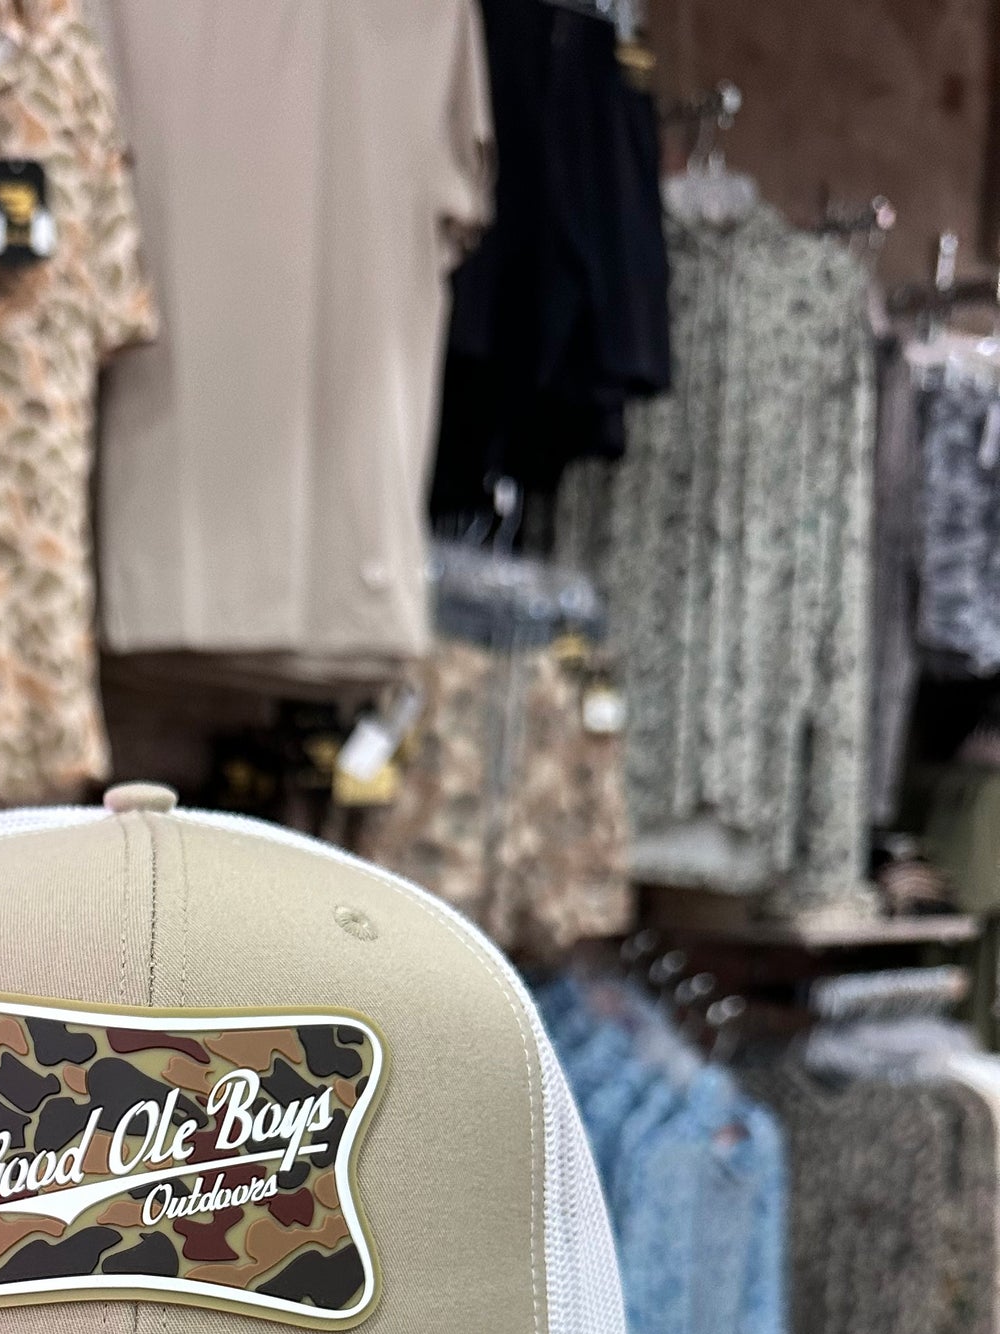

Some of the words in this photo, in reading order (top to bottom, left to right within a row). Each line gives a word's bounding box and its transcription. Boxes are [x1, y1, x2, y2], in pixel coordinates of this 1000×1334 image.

[109, 1087, 199, 1175] Ole
[207, 1069, 334, 1171] Boys
[142, 1171, 279, 1226] Outdoors
